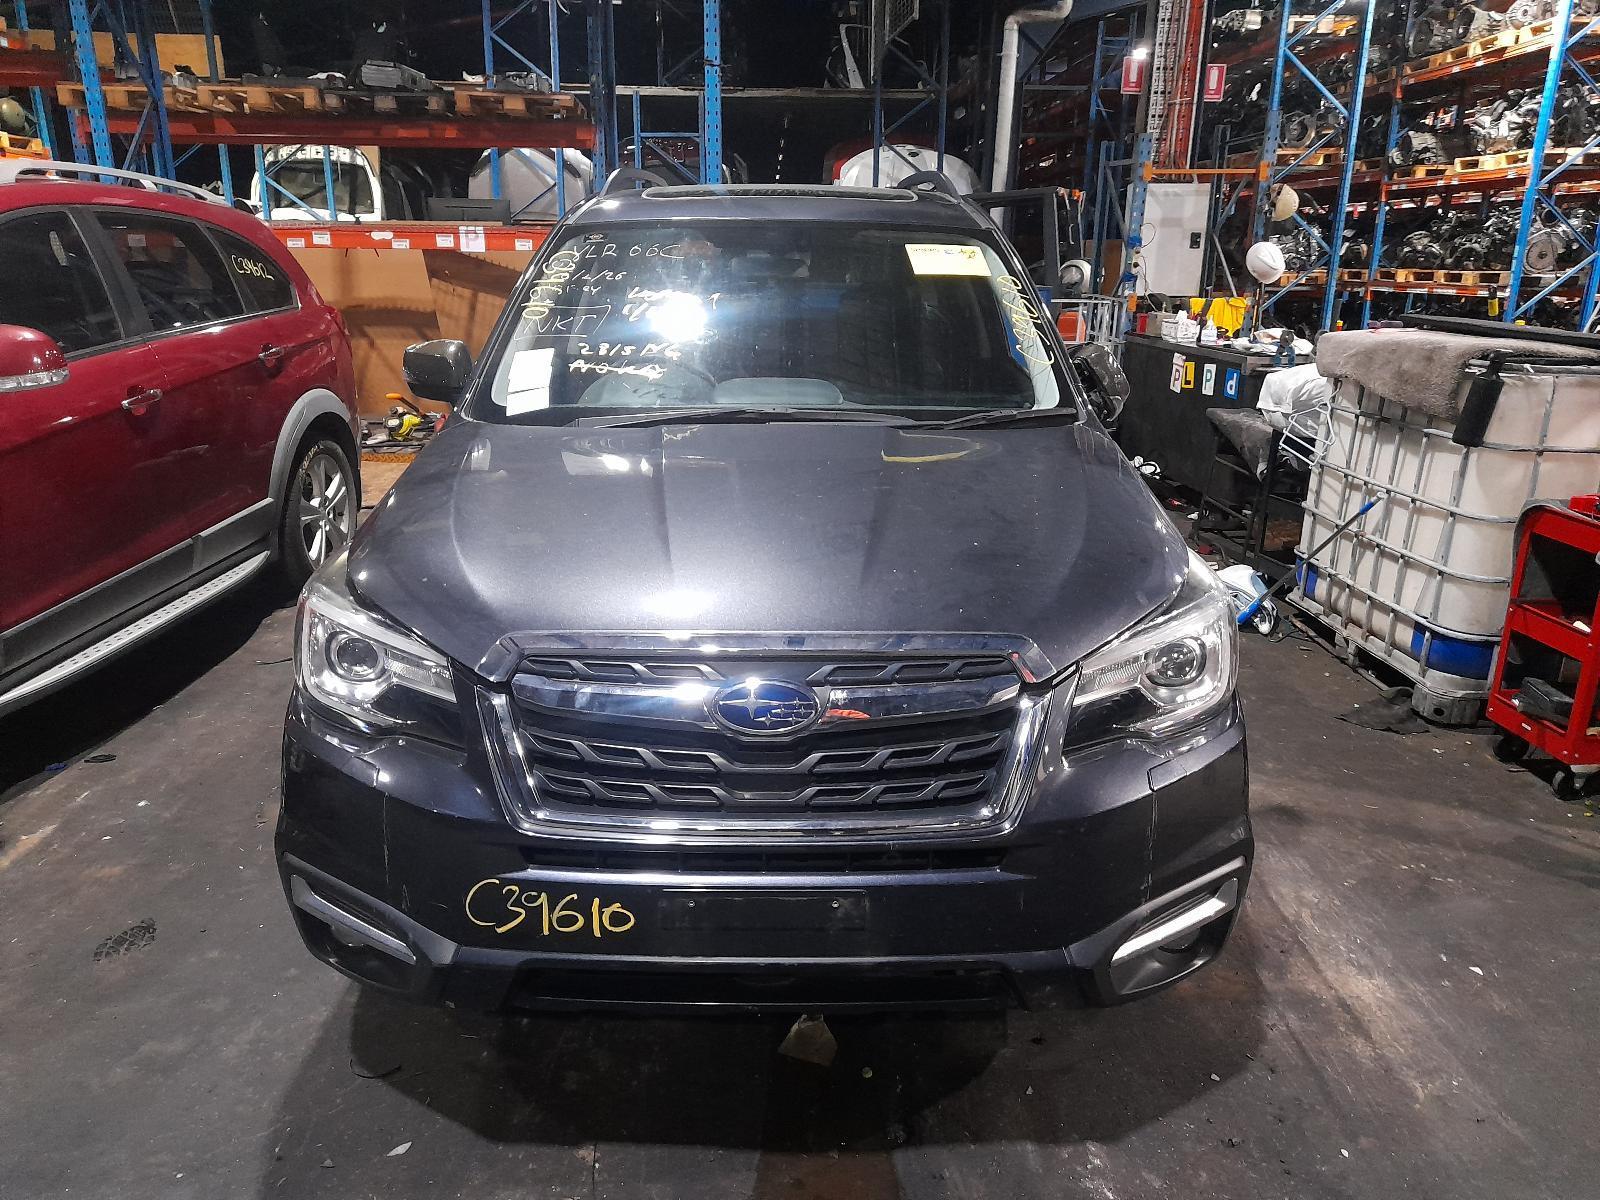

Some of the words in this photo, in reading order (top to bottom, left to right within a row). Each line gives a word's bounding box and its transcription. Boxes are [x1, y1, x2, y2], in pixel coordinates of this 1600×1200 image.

[997, 275, 1055, 366] C39610
[1184, 365, 1192, 386] L
[1204, 368, 1213, 390] P
[465, 878, 636, 937] C39610
